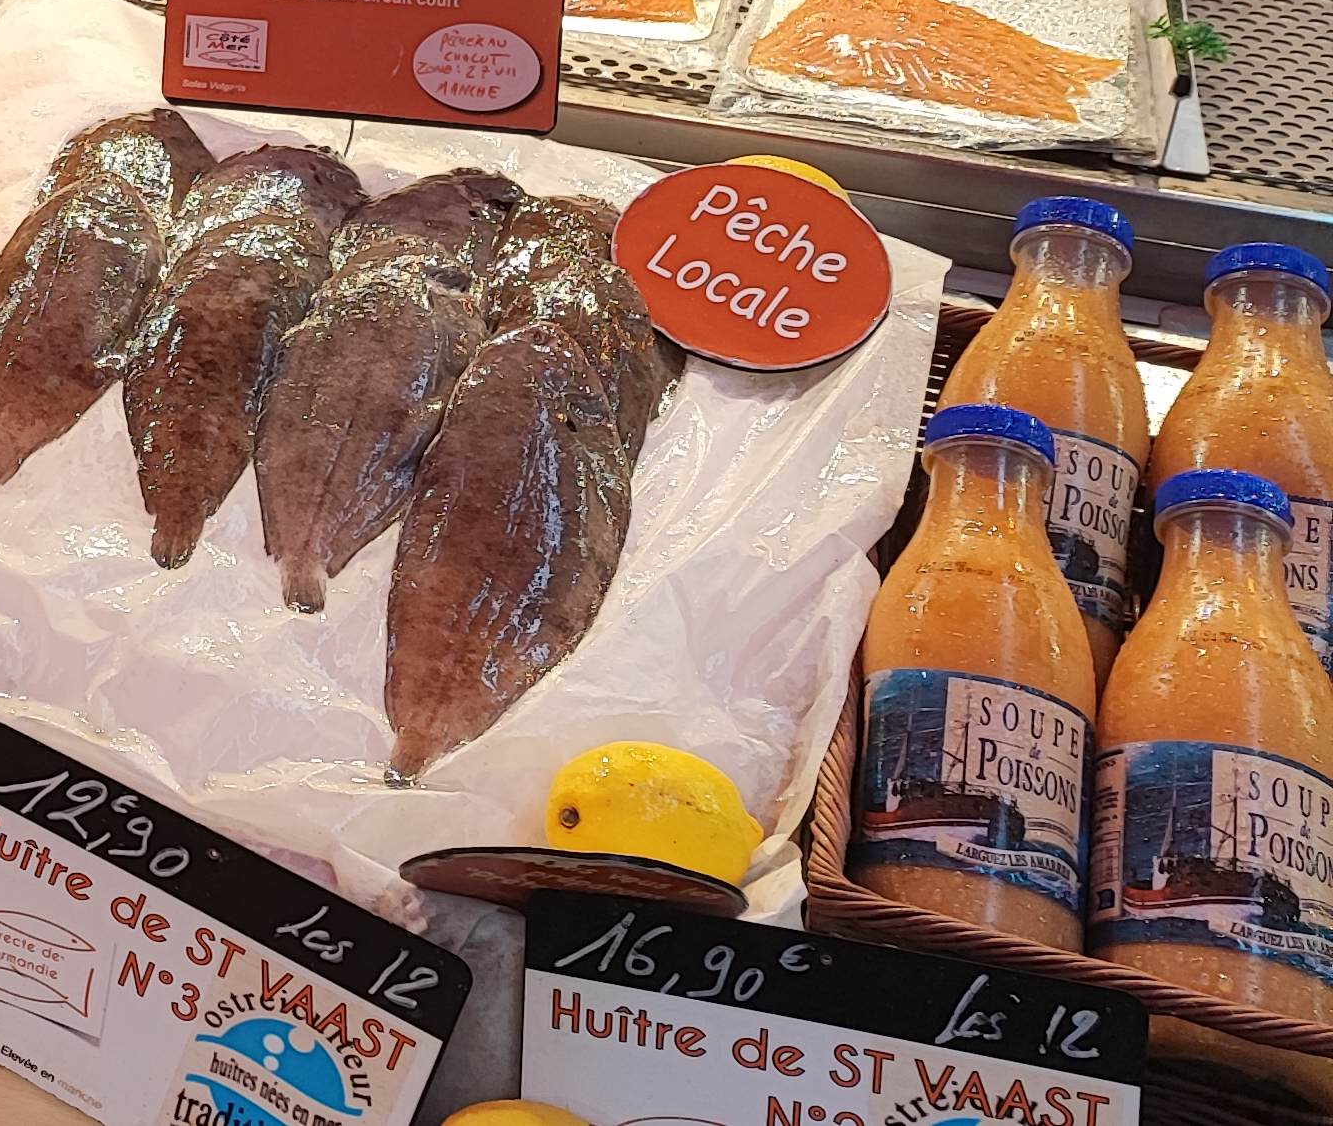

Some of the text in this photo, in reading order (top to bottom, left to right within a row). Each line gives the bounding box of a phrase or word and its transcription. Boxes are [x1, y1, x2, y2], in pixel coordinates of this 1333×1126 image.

[689, 184, 847, 283] Pêche
[646, 234, 810, 339] Locale
[976, 738, 1077, 813] POISSONS
[980, 697, 1079, 758] SOUPE
[110, 894, 169, 942] de
[186, 927, 246, 978] ST
[261, 959, 417, 1071] VAAST
[368, 949, 438, 1009] 12
[550, 990, 1110, 1126] Huître de ST VAAST
